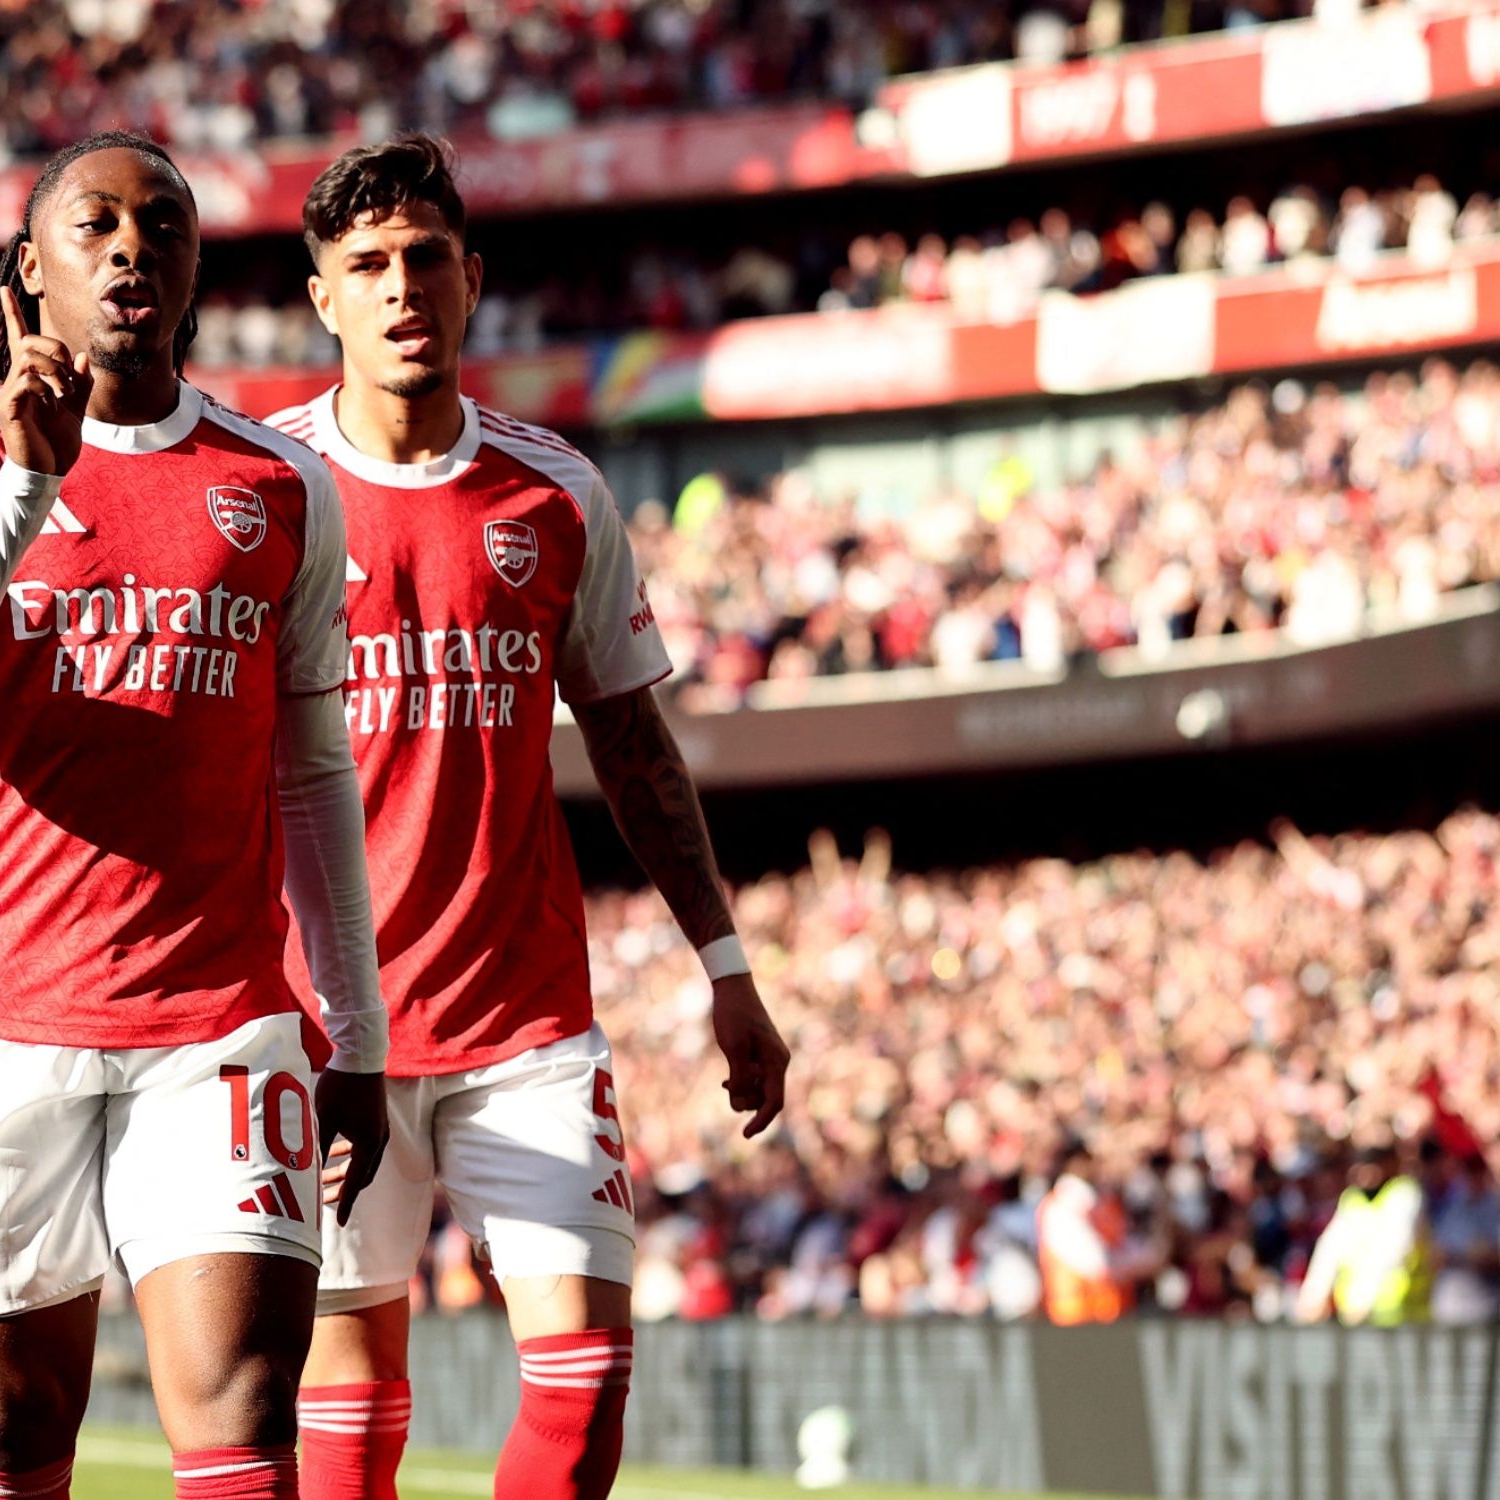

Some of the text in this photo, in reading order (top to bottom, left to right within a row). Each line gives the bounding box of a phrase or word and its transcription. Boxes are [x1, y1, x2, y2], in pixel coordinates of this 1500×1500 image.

[216, 495, 258, 512] Arsenal
[6, 573, 270, 645] Emirates
[51, 644, 238, 698] FLY BETTER
[345, 618, 542, 681] mirates
[407, 682, 516, 731] BETTER
[219, 1064, 311, 1170] 10
[592, 1067, 626, 1163] 5
[1346, 1324, 1492, 1500] RW
